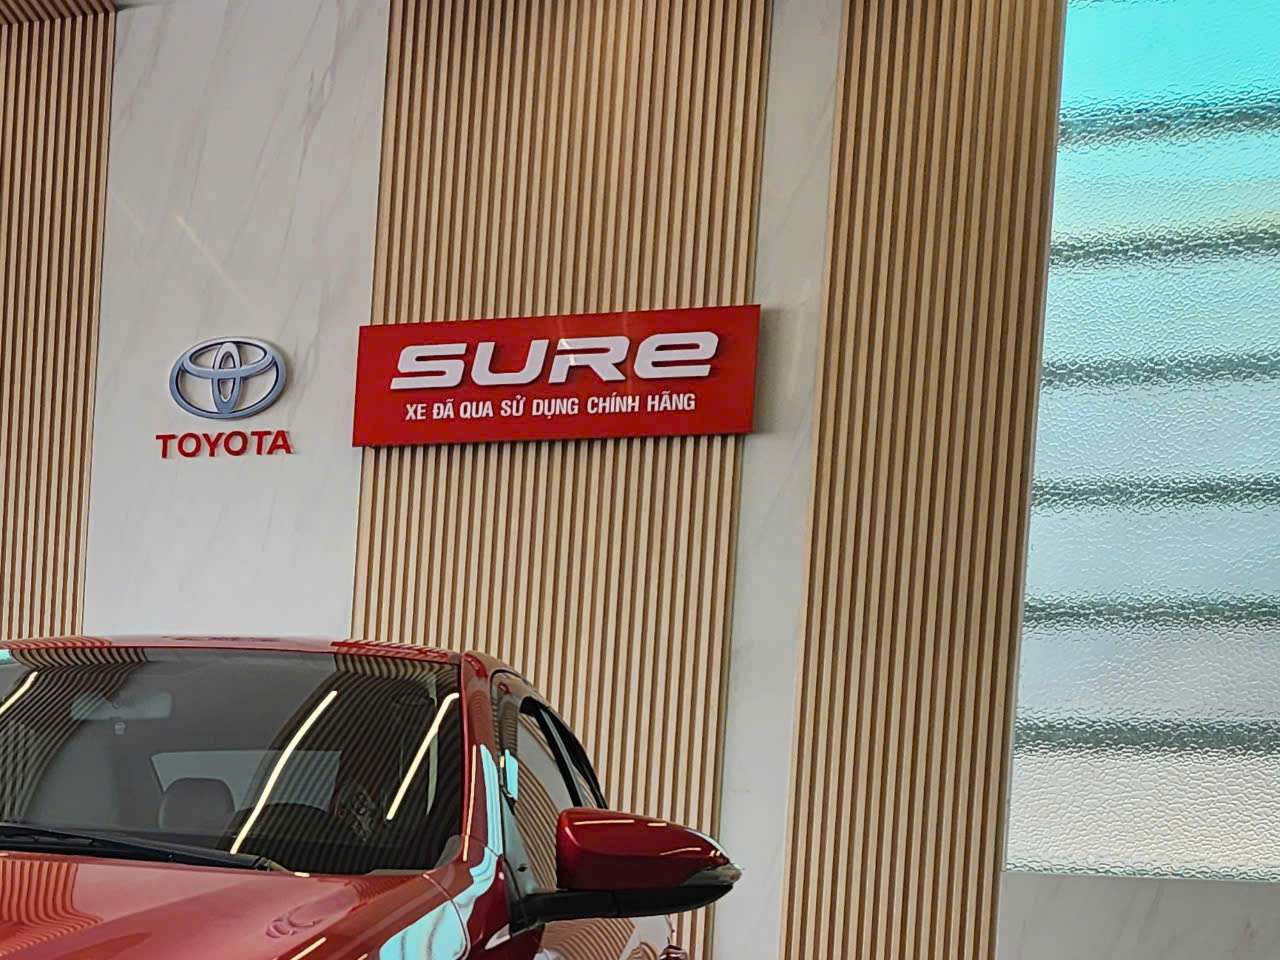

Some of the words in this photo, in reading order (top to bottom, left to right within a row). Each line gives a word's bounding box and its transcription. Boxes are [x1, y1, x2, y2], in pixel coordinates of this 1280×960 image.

[405, 403, 427, 421] XE
[432, 399, 455, 420] ĐÃ
[459, 401, 494, 419] QUA
[500, 395, 526, 417] SỬ
[531, 398, 579, 420] DỤNG
[586, 391, 640, 414] CHÍNH
[646, 390, 696, 412] HÃNG
[155, 429, 292, 459] TOYOTA
